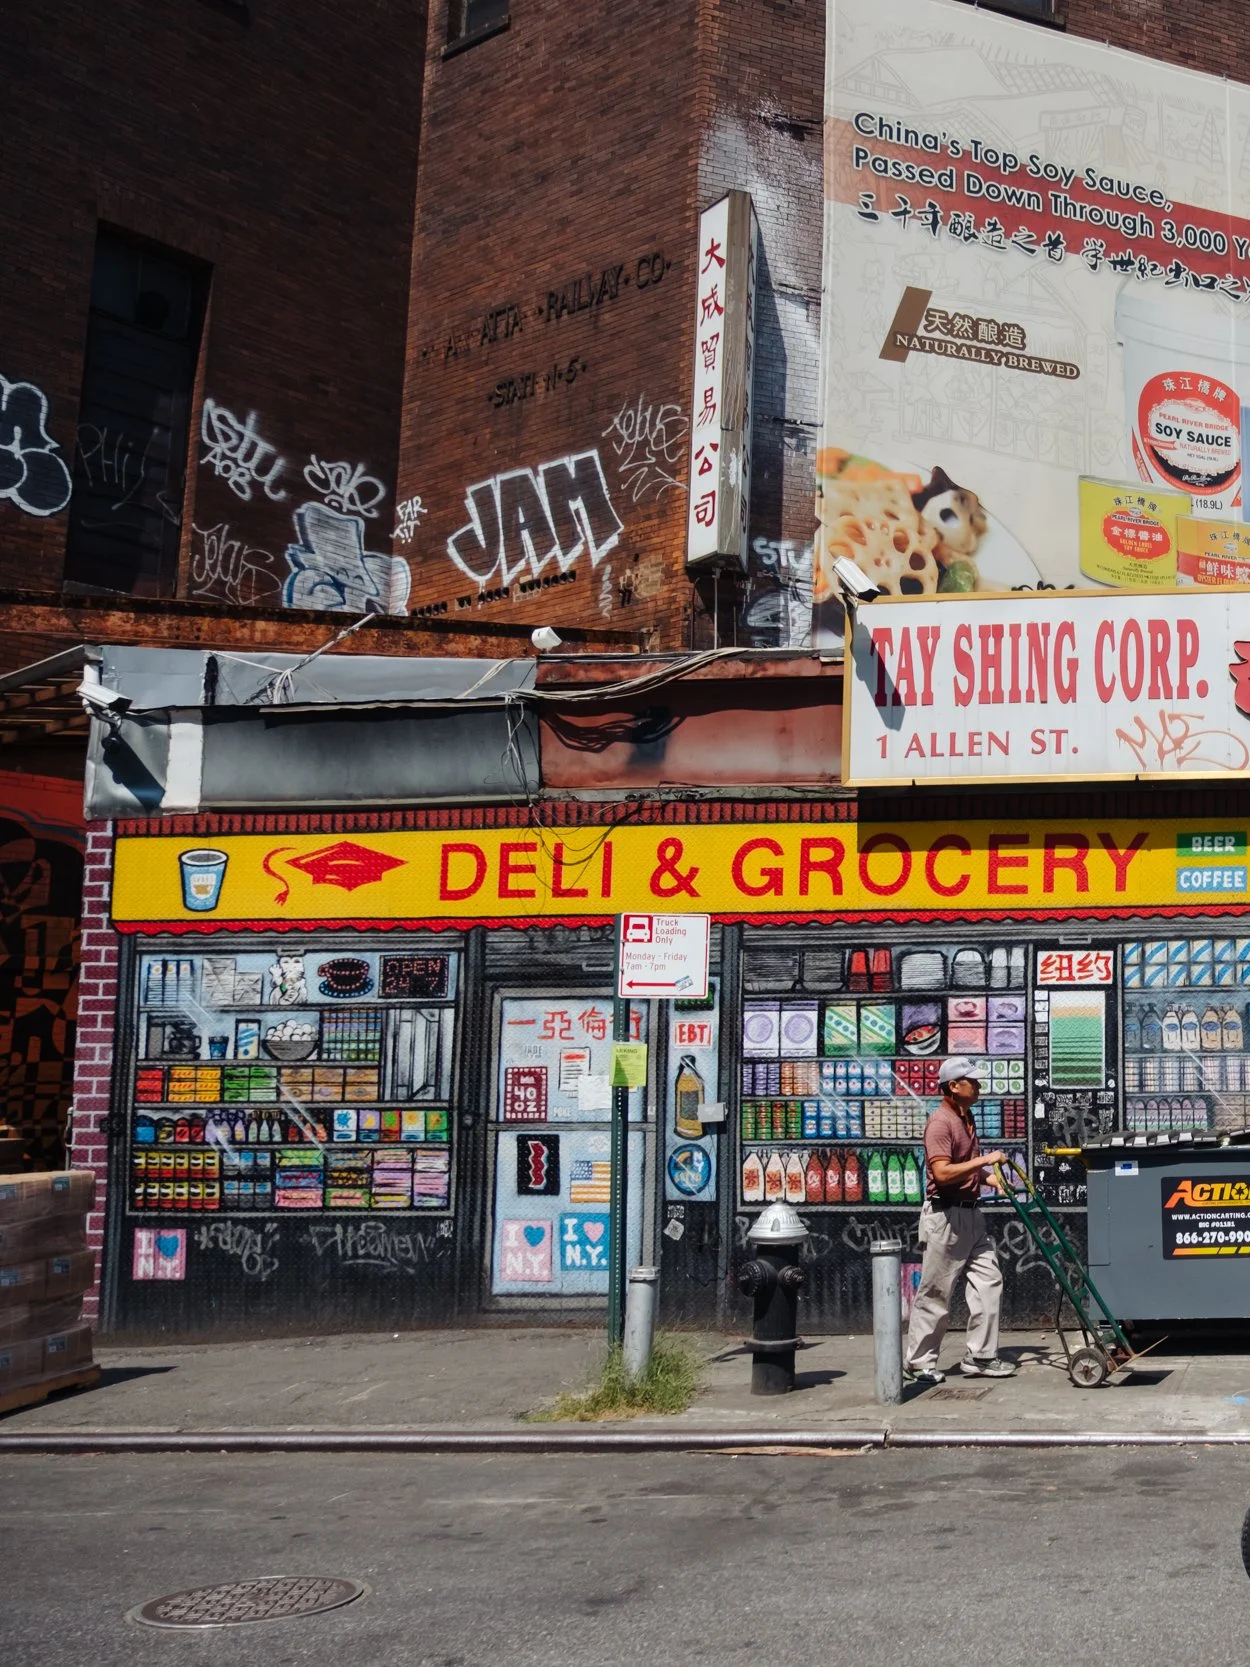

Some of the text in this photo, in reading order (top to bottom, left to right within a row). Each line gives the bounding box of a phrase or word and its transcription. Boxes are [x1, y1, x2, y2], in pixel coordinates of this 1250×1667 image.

[853, 112, 1174, 213] China's Top Soy Sauce,
[854, 146, 955, 191] Passed
[965, 172, 1043, 210] Down
[1050, 193, 1154, 239] Through
[1160, 220, 1227, 255] 3,000
[895, 334, 1078, 378] NATURALLY BREWED
[1158, 412, 1229, 432] PEARL RIVER BRIDGE
[1155, 422, 1182, 440] SOY
[1186, 430, 1231, 448] SAUCE
[1179, 442, 1211, 454] NATURALLY
[1195, 499, 1224, 511] (18.9L)
[446, 448, 625, 588] JAM
[1112, 514, 1160, 527] PEARL RIVER BRIDGE
[1204, 551, 1220, 559] PEARL
[1221, 553, 1237, 561] RIVER
[869, 618, 1210, 709] TAY SHING CORP.
[876, 728, 1079, 759] 1 ALLEN ST.
[1191, 835, 1237, 854] BEER
[440, 832, 1151, 901] DELI & GROCERY
[1179, 868, 1246, 890] COFFEE
[655, 927, 688, 937] Loading
[656, 918, 680, 927] Truck
[655, 935, 674, 946] Only
[386, 960, 442, 976] OPEN
[625, 952, 656, 964] Monday
[663, 952, 688, 963] Friday
[625, 962, 642, 971] 7am
[650, 962, 666, 972] 7pm
[1039, 952, 1113, 982] 纽约
[677, 1022, 708, 1047] EBT
[514, 1086, 537, 1102] 40
[514, 1101, 537, 1112] OZ
[505, 1223, 521, 1247] I
[562, 1217, 579, 1242] I
[137, 1231, 152, 1255] I
[504, 1251, 550, 1278] N.Y.
[565, 1243, 608, 1268] N.Y.
